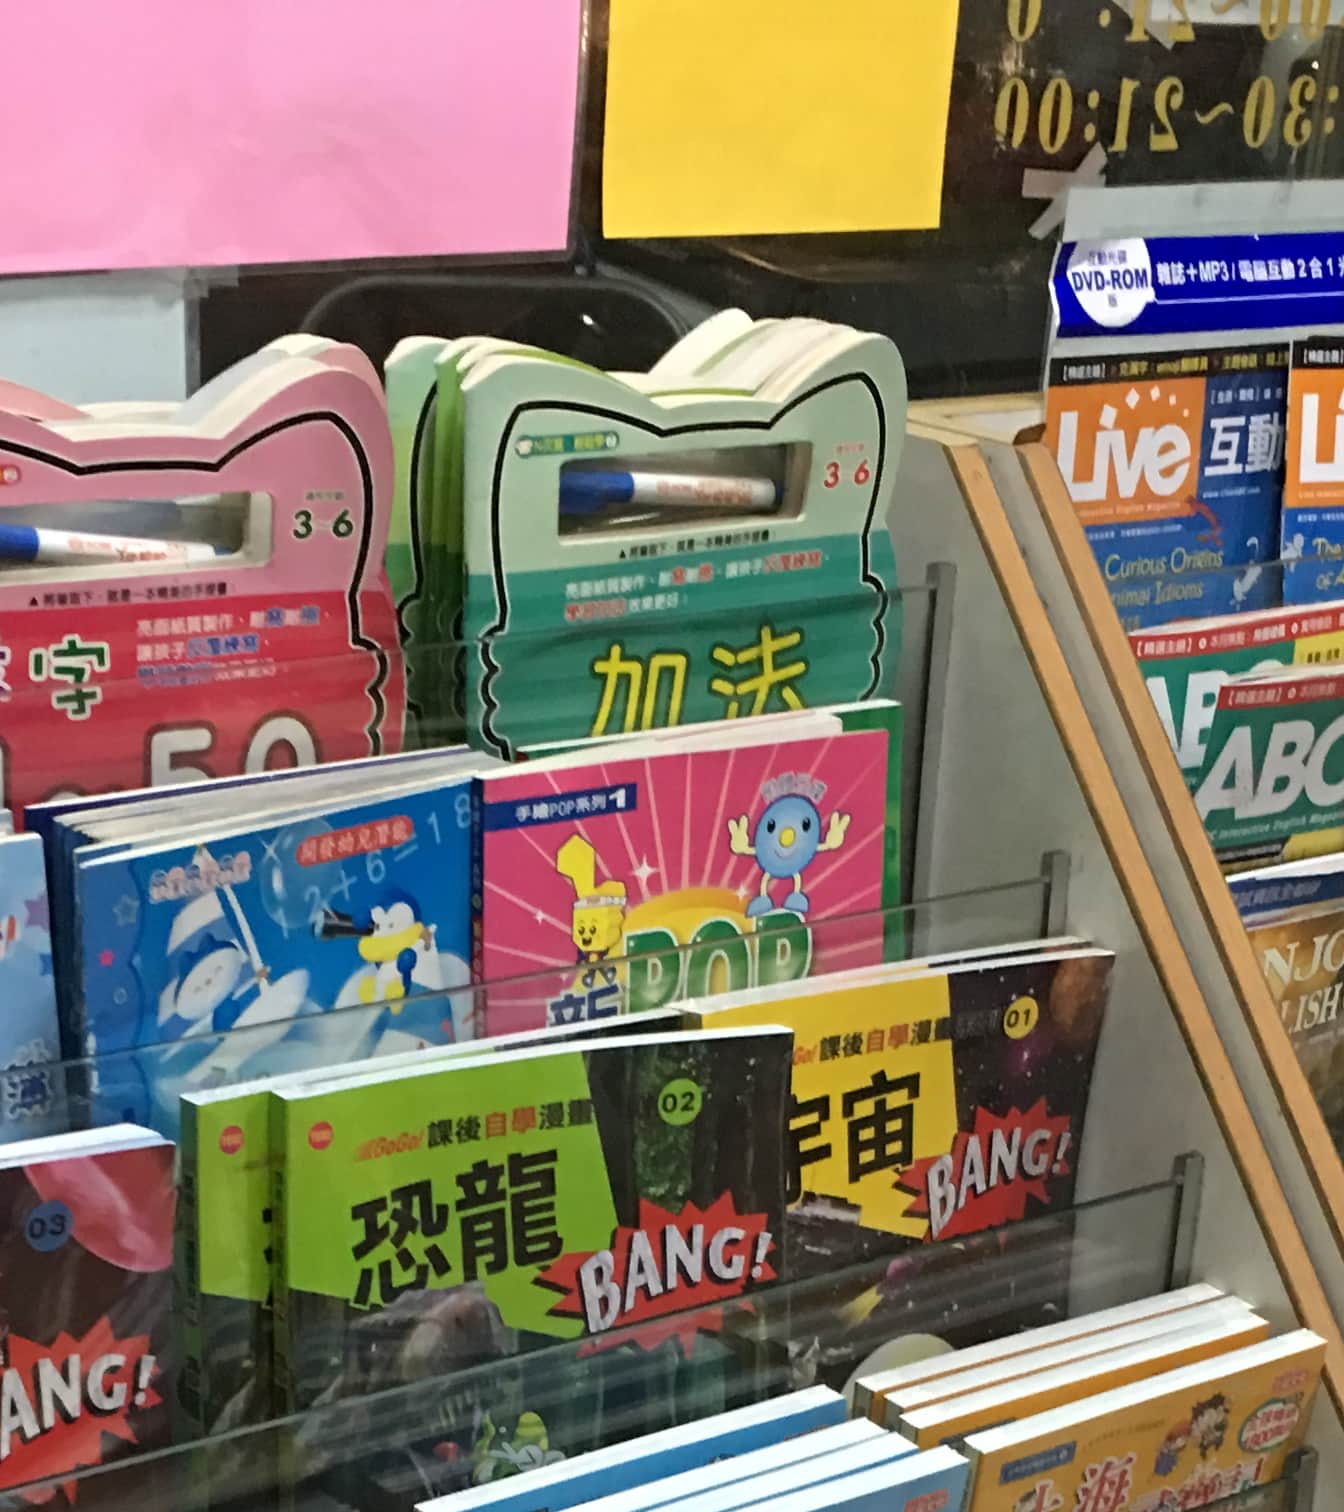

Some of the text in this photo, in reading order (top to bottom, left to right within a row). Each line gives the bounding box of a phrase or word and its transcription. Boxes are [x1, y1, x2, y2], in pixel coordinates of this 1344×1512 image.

[1072, 267, 1150, 293] DVD-ROM
[1057, 403, 1192, 501] Live
[1006, 1008, 1033, 1028] 01
[427, 1099, 594, 1149] 課後自學漫畫
[659, 1090, 697, 1113] 02
[926, 1125, 1072, 1247] BANG!
[27, 1216, 65, 1239] 03
[349, 1147, 564, 1312] 恐龍
[578, 1222, 773, 1335] BANG!
